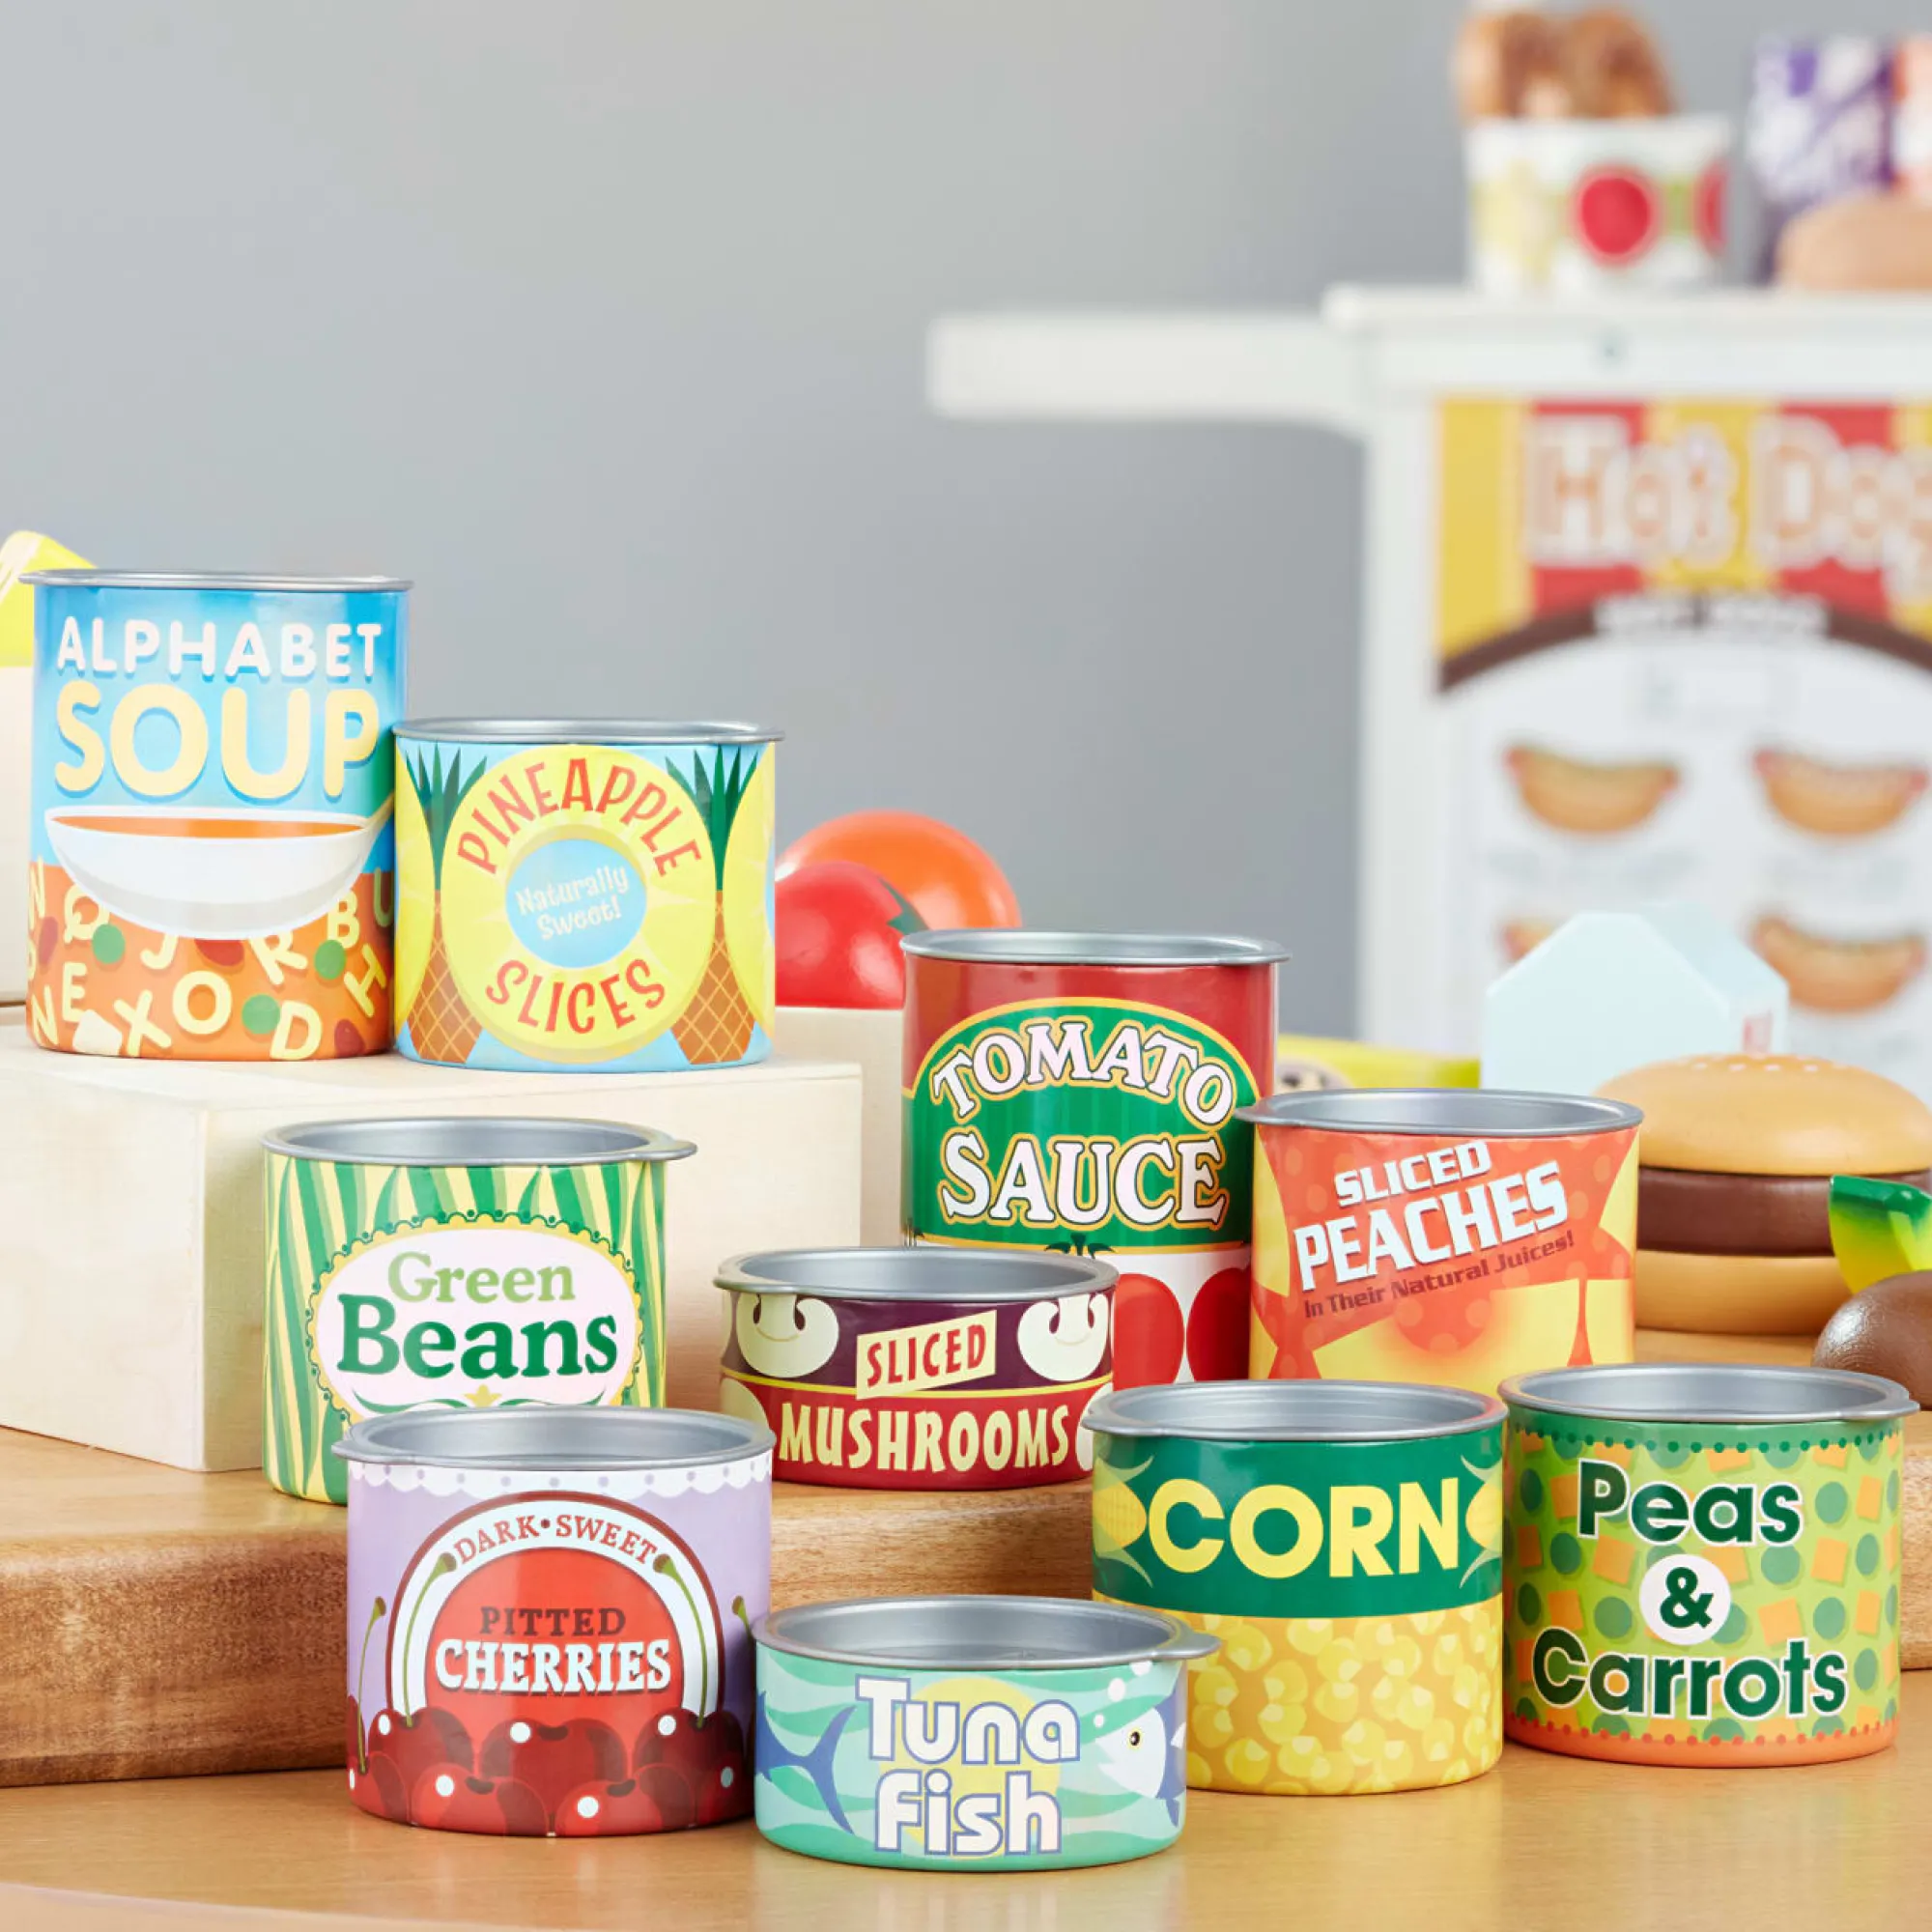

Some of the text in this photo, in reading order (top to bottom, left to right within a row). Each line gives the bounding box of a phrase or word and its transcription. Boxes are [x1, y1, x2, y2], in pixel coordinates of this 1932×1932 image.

[56, 615, 383, 680] ALPHABET
[55, 680, 381, 799] SOUP
[457, 757, 701, 877] PINEAPPLE
[516, 866, 630, 915] Naturally
[537, 902, 622, 941] Sweet!
[486, 958, 666, 1034] SLICES
[931, 1018, 1236, 1128] TOMATO
[939, 1130, 1232, 1227] SAUCE
[1335, 1140, 1492, 1208] SLICED
[1293, 1161, 1569, 1292] PEACHES
[387, 1253, 577, 1303] Green
[1304, 1229, 1576, 1319] In Their Natural Juices!
[337, 1293, 618, 1379] Beans
[866, 1324, 987, 1388] SLICED
[779, 1404, 1069, 1474] MUSHROOMS
[1148, 1478, 1459, 1578] CORN
[1577, 1459, 1803, 1547] Peas
[479, 1605, 627, 1636] PITTED
[1659, 1567, 1715, 1629] &
[435, 1638, 671, 1697] CHERRIES
[1531, 1627, 1849, 1721] Carrots
[854, 1674, 1081, 1766] Tuna
